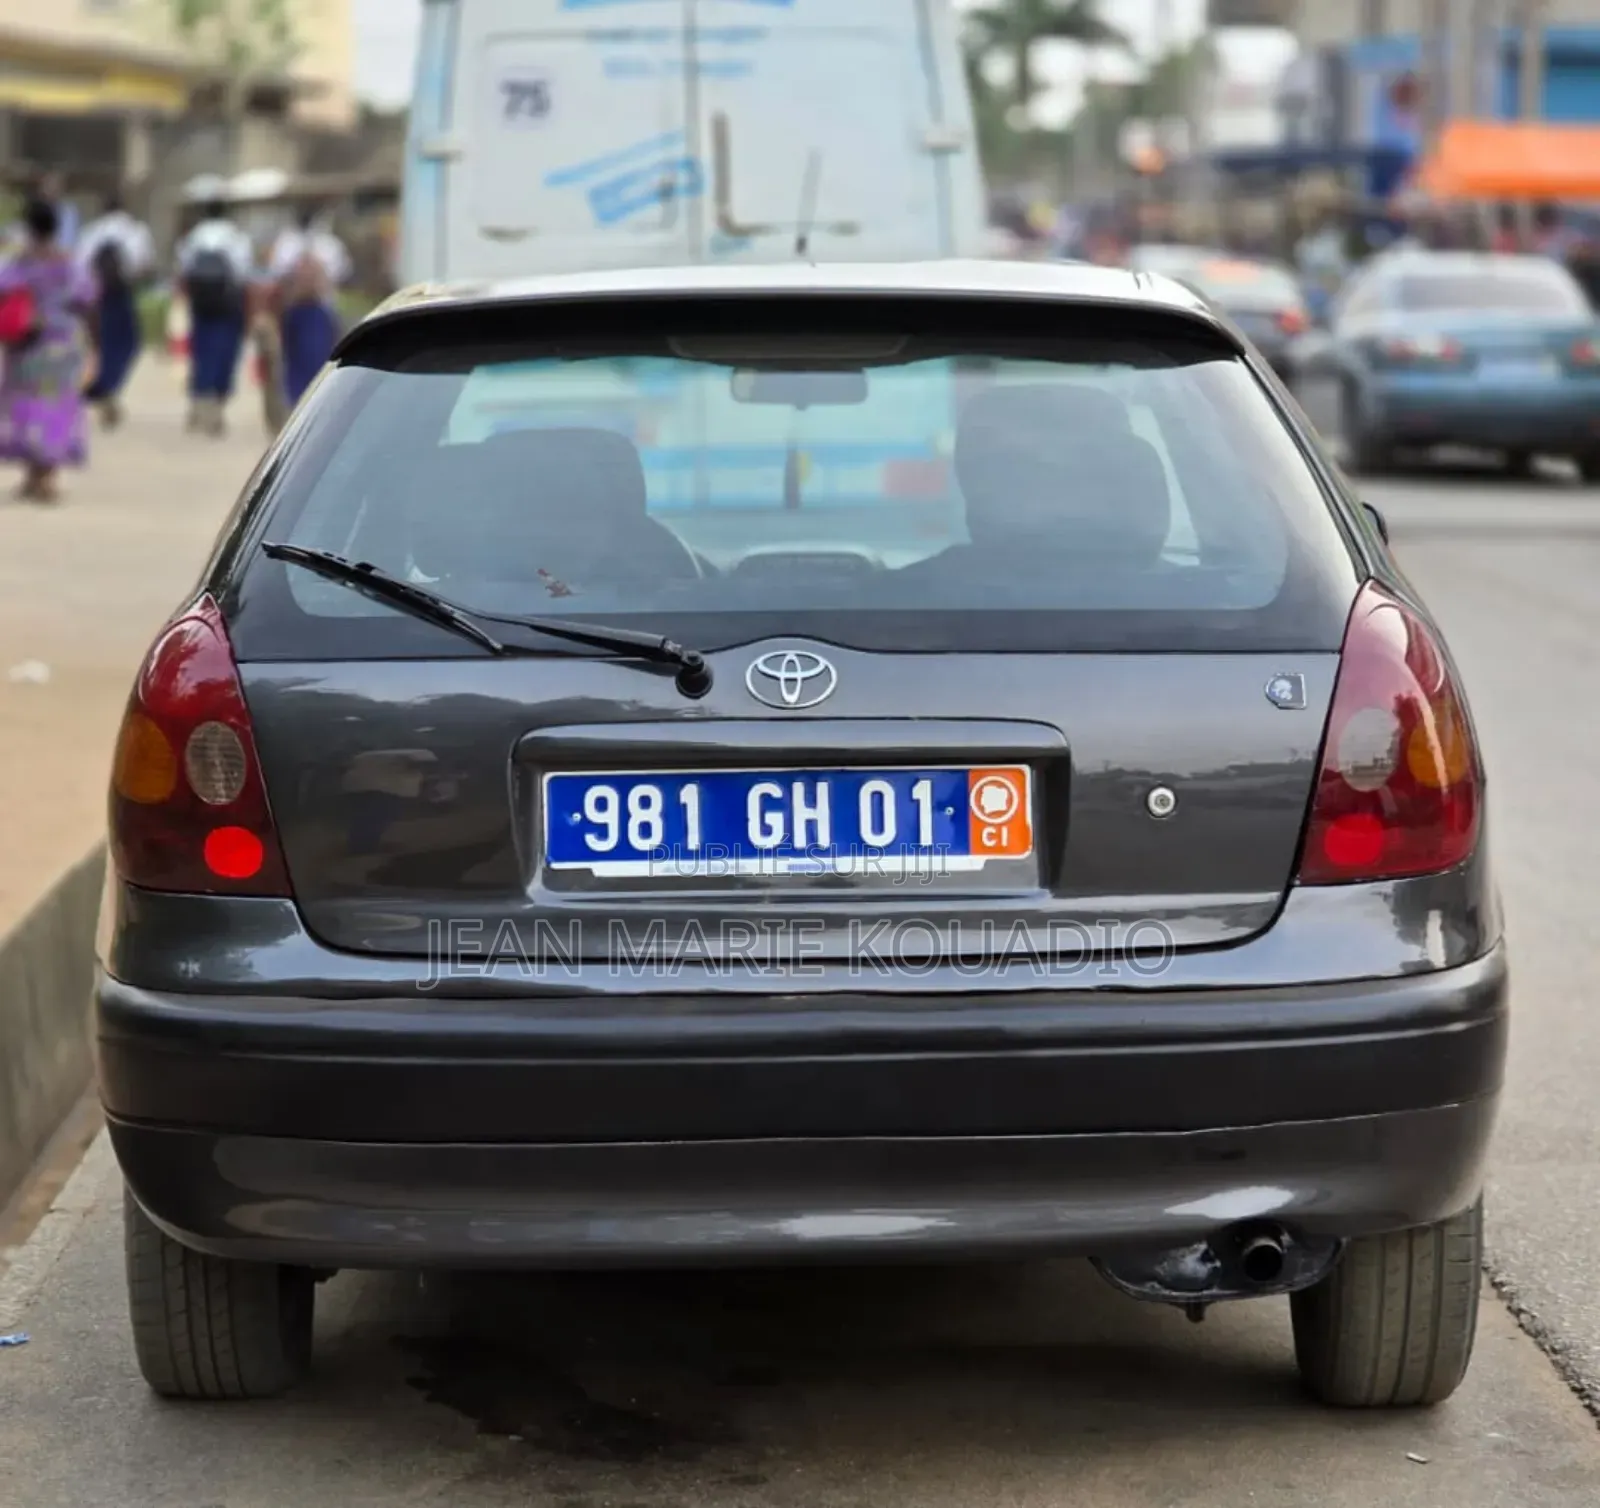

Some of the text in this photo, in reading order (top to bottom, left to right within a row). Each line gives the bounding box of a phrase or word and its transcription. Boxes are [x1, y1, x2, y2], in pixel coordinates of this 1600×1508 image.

[500, 80, 551, 121] 75
[584, 779, 934, 852] 981 GH 01
[982, 826, 1008, 847] CI
